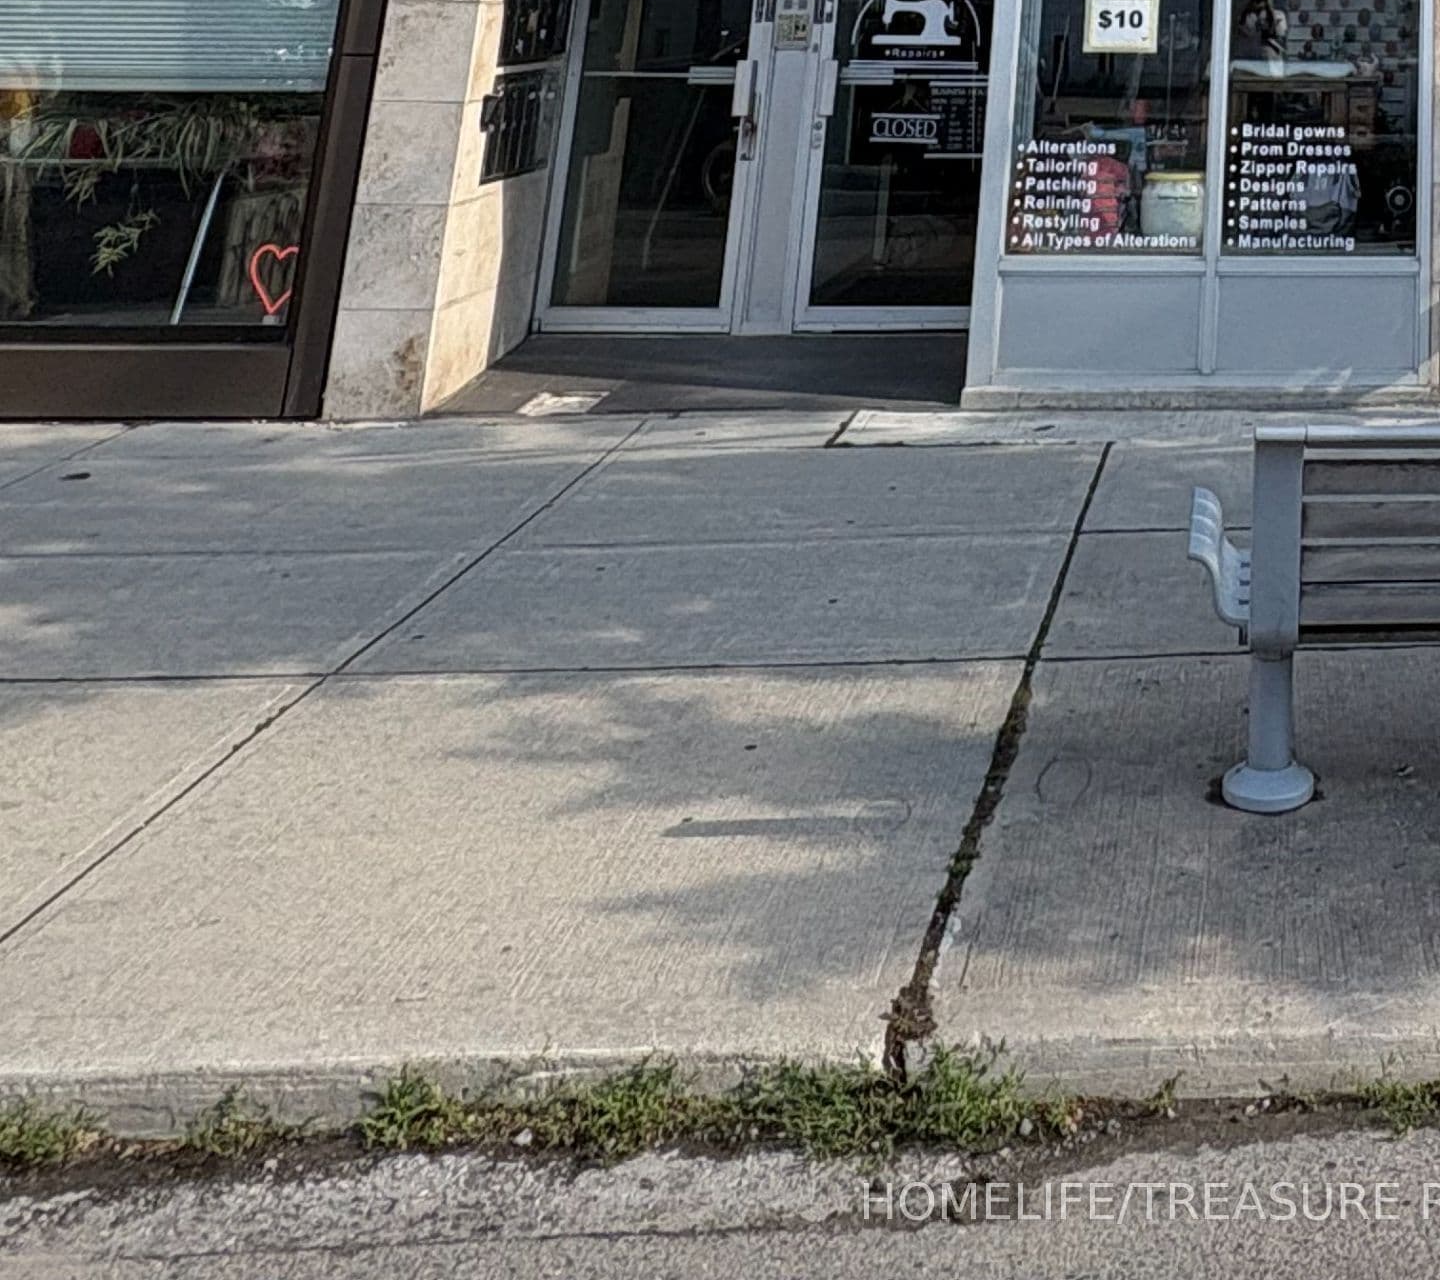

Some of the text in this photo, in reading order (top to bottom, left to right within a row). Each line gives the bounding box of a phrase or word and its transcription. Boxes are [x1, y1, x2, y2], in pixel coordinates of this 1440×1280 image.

[1097, 9, 1144, 30] $10
[873, 118, 938, 139] CLOSED
[1242, 124, 1345, 140] Bridal gowns
[1026, 141, 1117, 154] Alterations
[1241, 142, 1351, 156] Prom Dresses
[1026, 158, 1098, 175] Tailoring
[1240, 160, 1357, 176] Zipper Repairs
[1025, 177, 1097, 193] Patching
[1240, 179, 1305, 195] Designs
[1024, 195, 1091, 212] Relining
[1240, 197, 1307, 211] Patterns
[1022, 215, 1100, 230] Restyling
[1238, 216, 1307, 232] Samples
[1021, 233, 1197, 249] All Types of Alterations
[1238, 234, 1355, 251] Manufacturing
